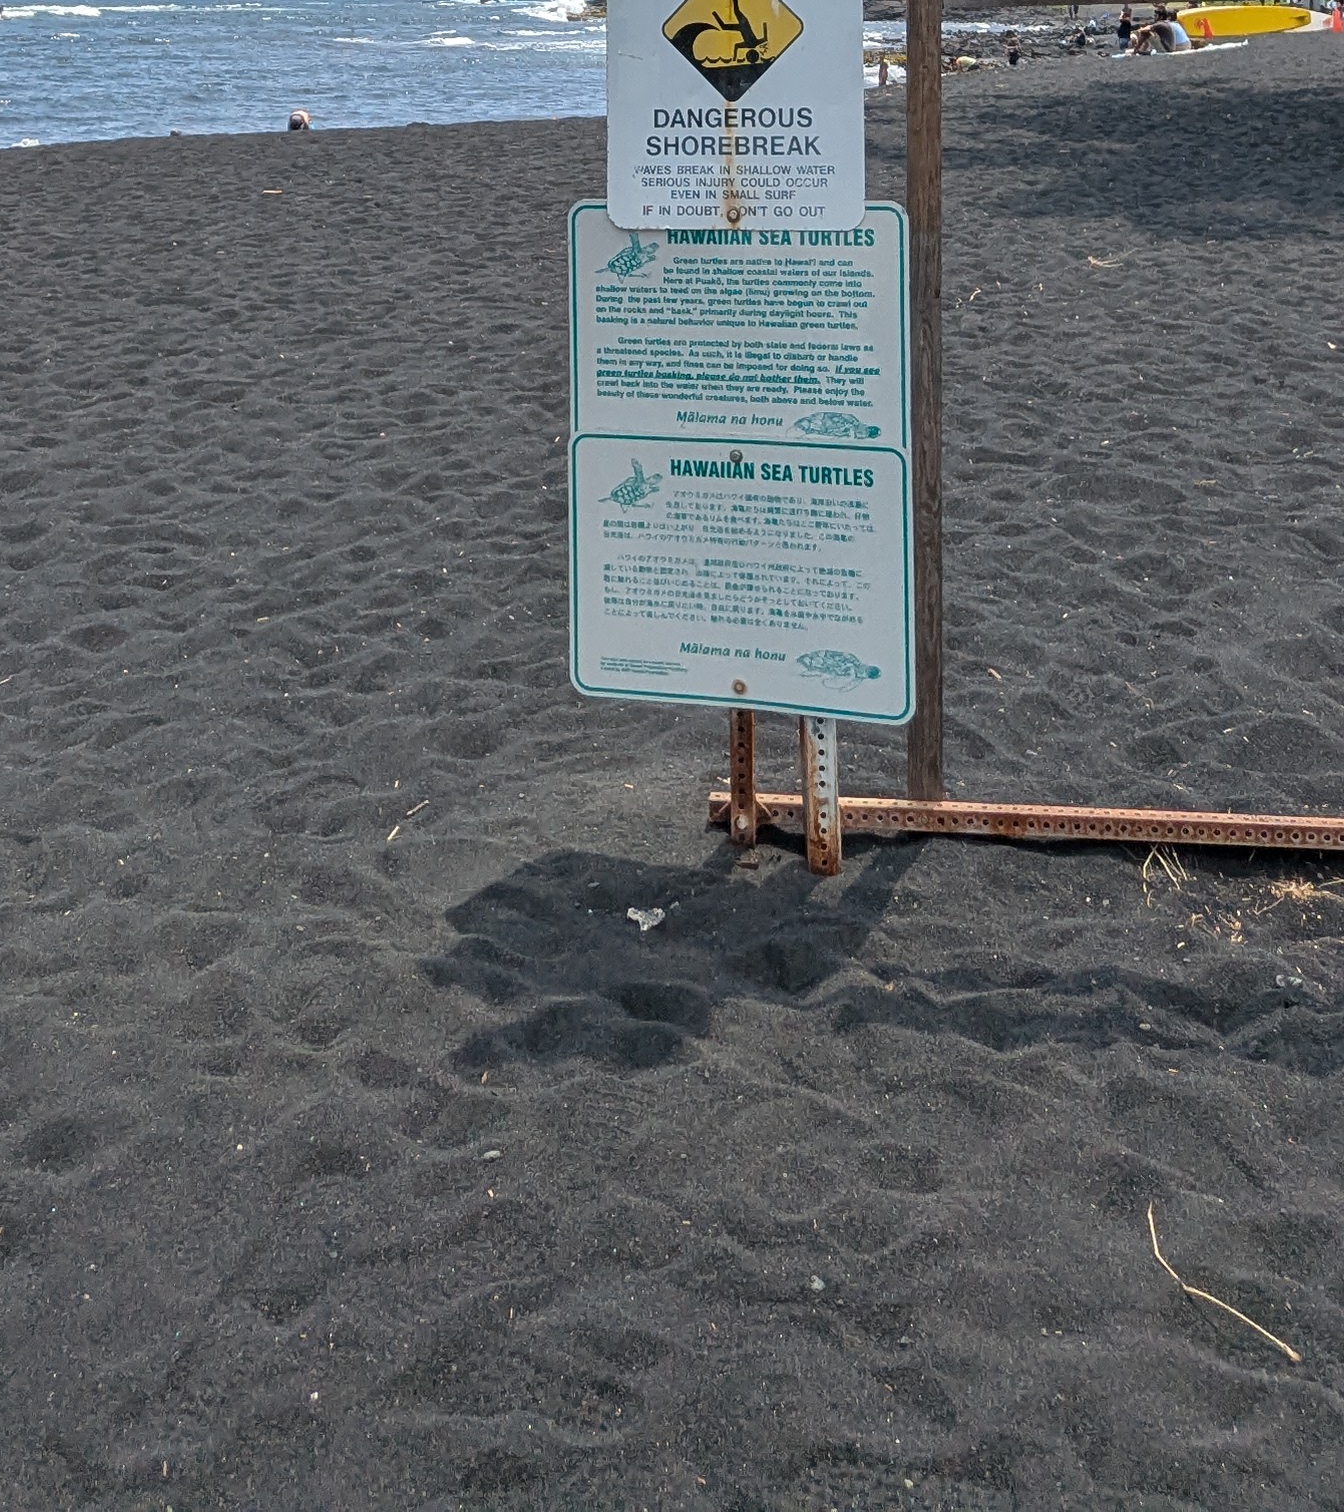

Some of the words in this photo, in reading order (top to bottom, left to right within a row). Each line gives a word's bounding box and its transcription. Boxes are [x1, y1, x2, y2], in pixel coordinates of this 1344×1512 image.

[653, 107, 813, 129] DANGEROUS
[646, 136, 822, 157] SHOREBREAK
[632, 165, 671, 174] WAVES
[677, 165, 714, 174] BREAK
[719, 164, 730, 175] IN
[736, 165, 791, 174] SHALLOW
[796, 165, 834, 174] WATER
[641, 177, 690, 186] SERIOUS
[695, 177, 735, 187] INJURY
[740, 178, 780, 187] COULD
[785, 178, 827, 187] OCCUR
[671, 190, 700, 198] EVEN
[705, 190, 716, 198] IN
[722, 190, 759, 199] SMALL
[765, 190, 795, 199] SURF
[643, 205, 653, 215] IF
[659, 205, 670, 215] IN
[730, 206, 769, 217] ON'T
[773, 206, 792, 216] GO
[799, 206, 825, 216] OUT
[666, 228, 754, 245] HAWAIIAN
[758, 230, 791, 247] SEA
[799, 229, 875, 247] TURTLES
[670, 459, 754, 480] HAWAIIAN
[760, 463, 792, 481] SEA
[798, 465, 873, 487] TURTLES
